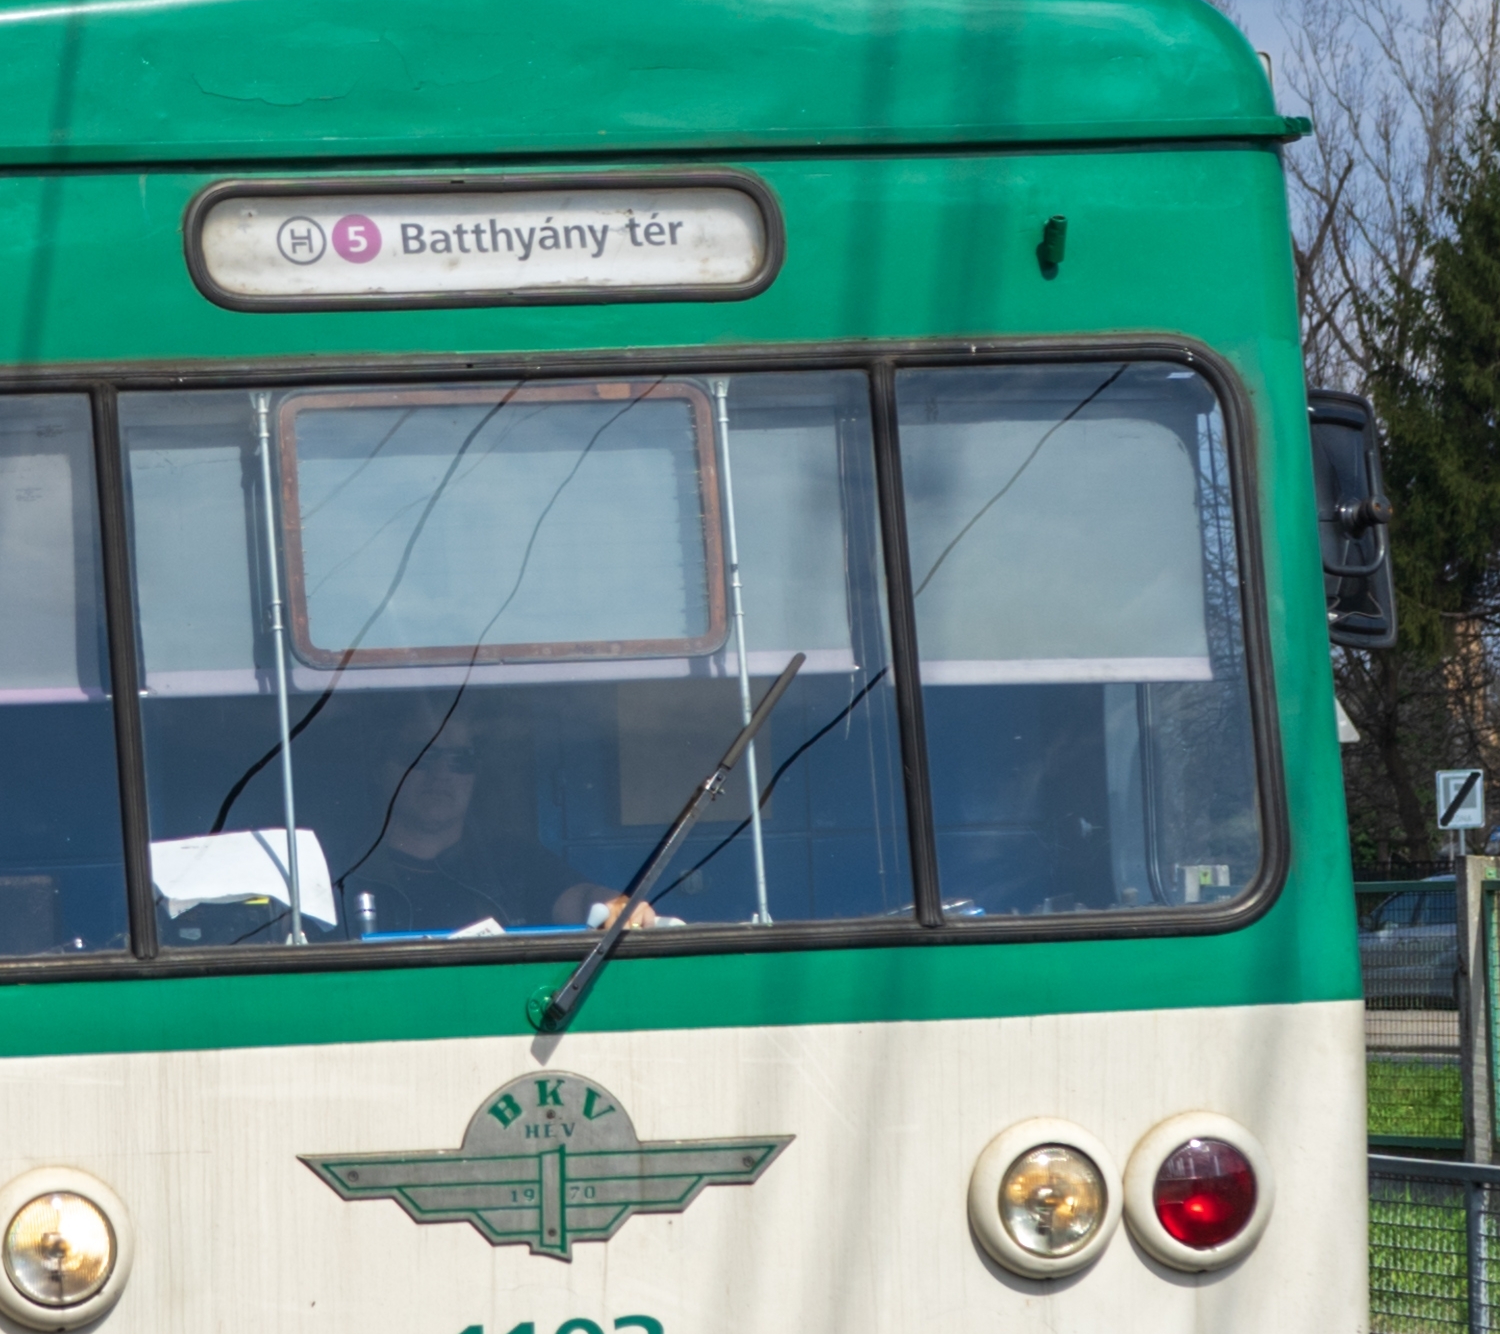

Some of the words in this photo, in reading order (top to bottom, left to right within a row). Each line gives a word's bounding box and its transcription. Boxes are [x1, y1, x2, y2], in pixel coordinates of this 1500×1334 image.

[401, 217, 609, 259] Batthyány
[627, 212, 684, 248] tér
[487, 1079, 616, 1130] BKV
